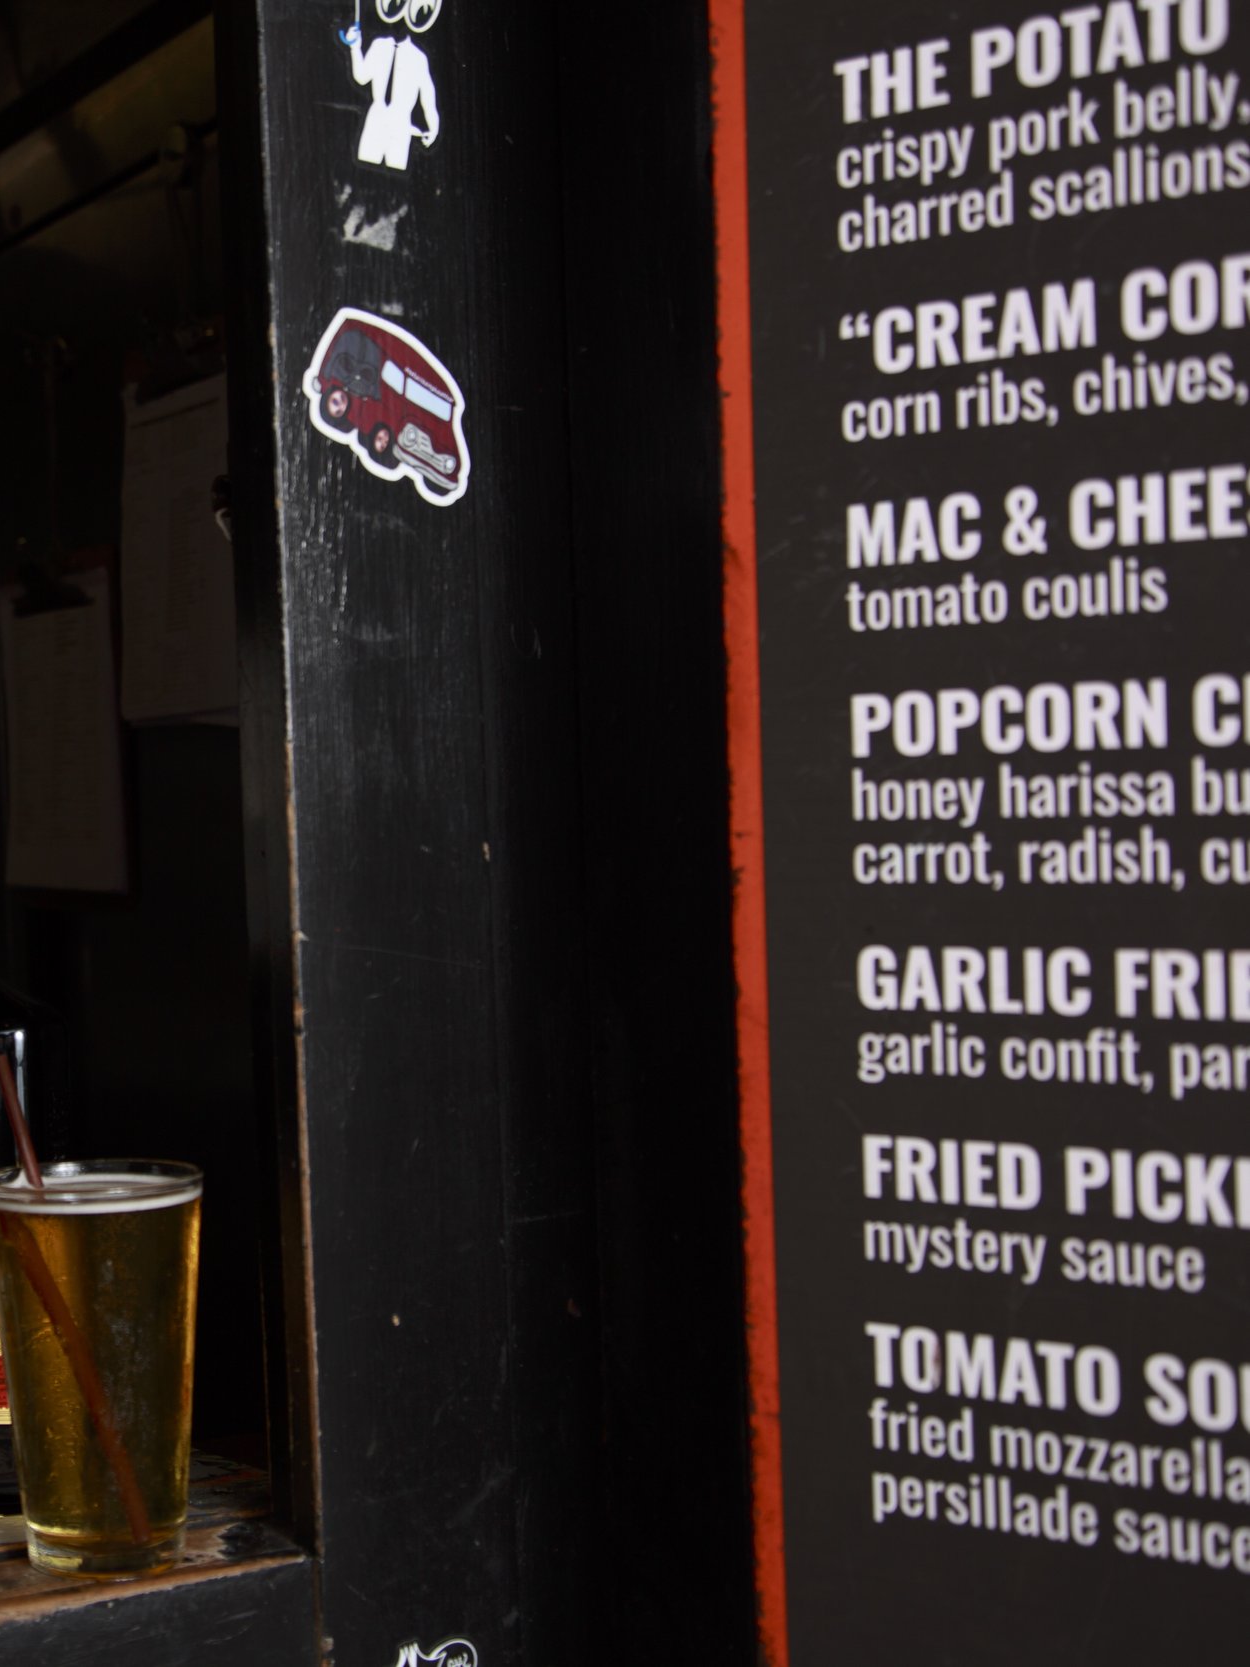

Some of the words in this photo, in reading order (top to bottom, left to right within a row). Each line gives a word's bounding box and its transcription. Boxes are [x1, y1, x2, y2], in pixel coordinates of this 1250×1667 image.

[834, 39, 950, 123] THE
[971, 0, 1228, 98] POTATO
[837, 125, 974, 188] crispy
[989, 89, 1099, 173] pork
[1114, 64, 1250, 138] belly,
[838, 170, 1013, 252] charred
[1030, 142, 1250, 220] scallions
[839, 278, 1096, 374] “CREAM
[842, 392, 940, 442] corn
[956, 369, 1058, 429] ribs,
[1074, 352, 1248, 415] chives,
[847, 493, 981, 568] MAC
[1003, 486, 1047, 555] &
[1069, 465, 1250, 550] CHEE
[846, 573, 1007, 632] tomato
[1023, 557, 1168, 620] coulis
[851, 678, 1167, 758] POPCORN
[1193, 674, 1250, 747] C
[852, 768, 984, 827] honey
[999, 762, 1174, 818] harissa
[853, 832, 1003, 890] carrot,
[1019, 825, 1184, 890] radish,
[857, 945, 1091, 1016] GARLIC
[858, 1021, 985, 1083] garlic
[1001, 1028, 1153, 1092] confit,
[863, 1134, 1041, 1210] FRIED
[864, 1219, 1046, 1284] mystery
[1062, 1238, 1204, 1292] sauce
[865, 1322, 1120, 1416] TOMATO
[1145, 1354, 1250, 1431] SO
[869, 1398, 973, 1461] fried
[991, 1426, 1250, 1503] mozzarella
[873, 1473, 1097, 1545] persillade
[1115, 1510, 1250, 1572] sauce
